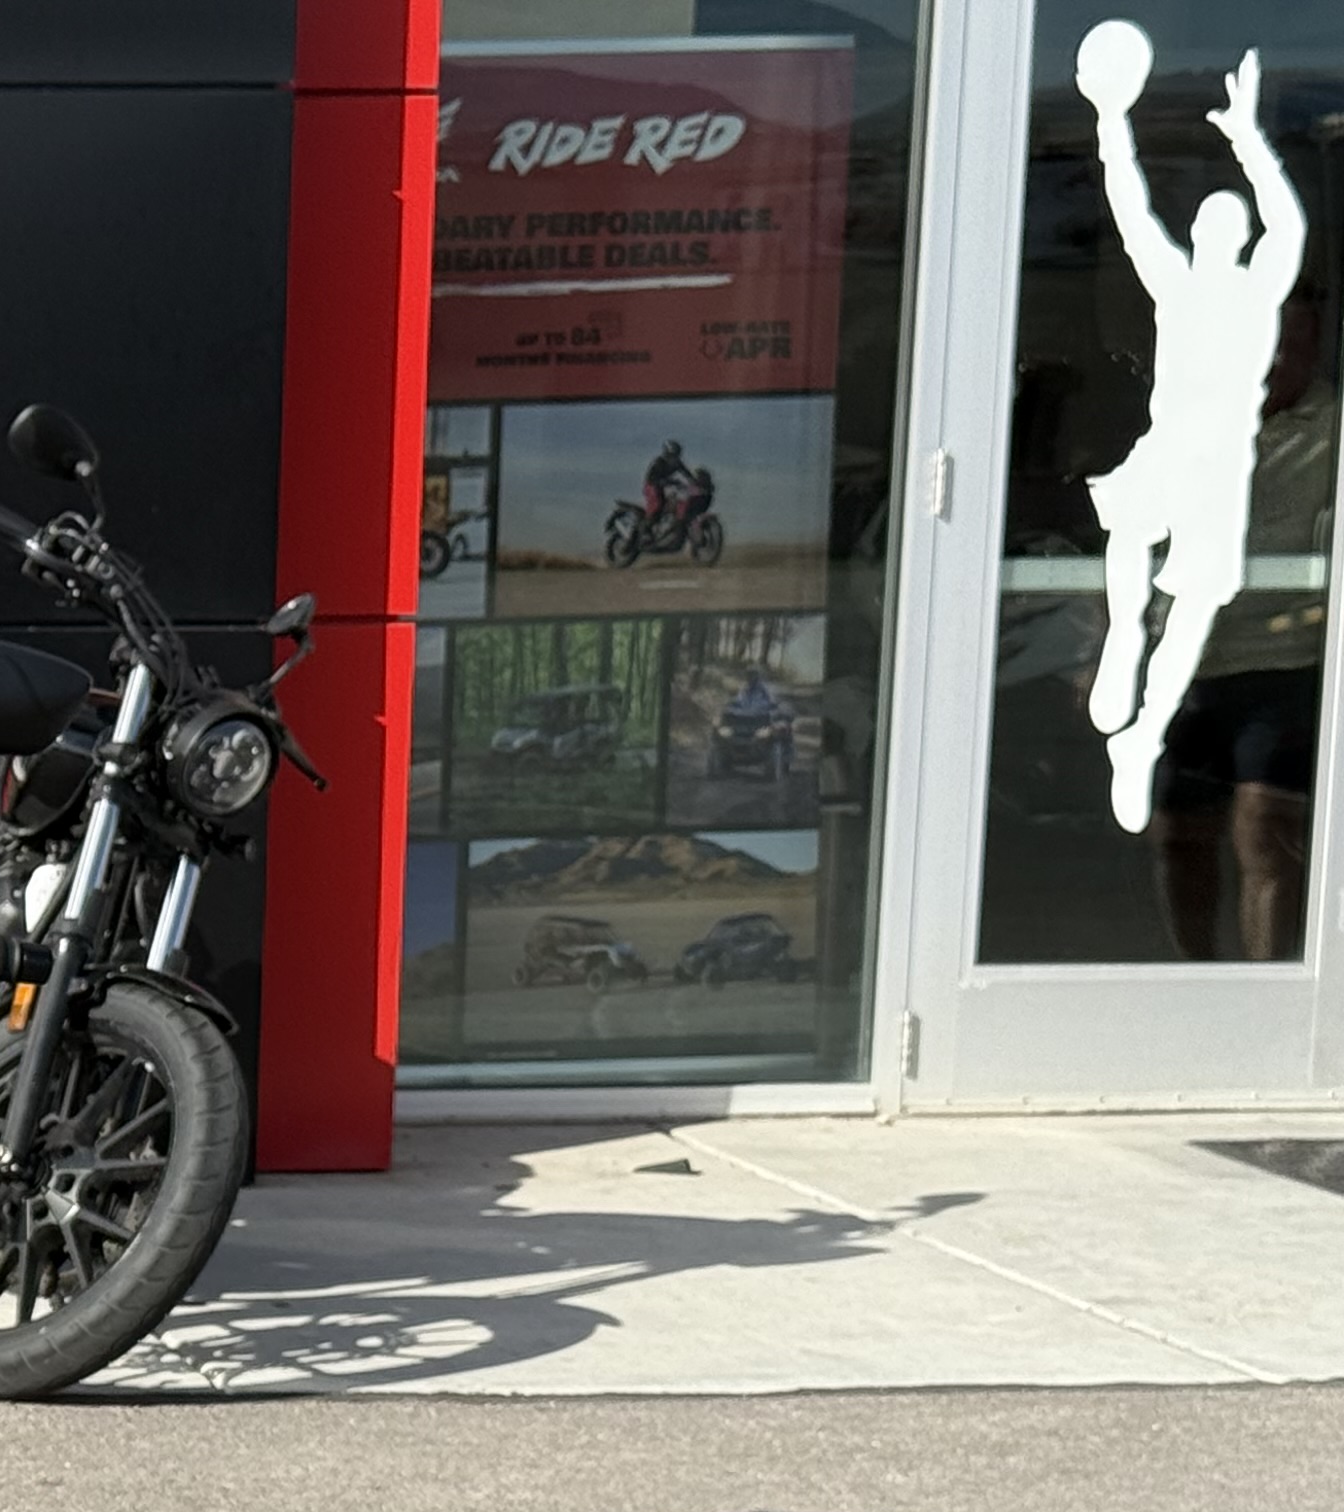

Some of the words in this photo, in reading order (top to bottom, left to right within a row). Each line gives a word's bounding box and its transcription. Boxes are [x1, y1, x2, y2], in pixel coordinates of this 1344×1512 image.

[487, 113, 627, 177] RIDE
[622, 110, 747, 176] RED
[525, 207, 781, 238] PERFORMANCE.
[724, 336, 792, 361] APR
